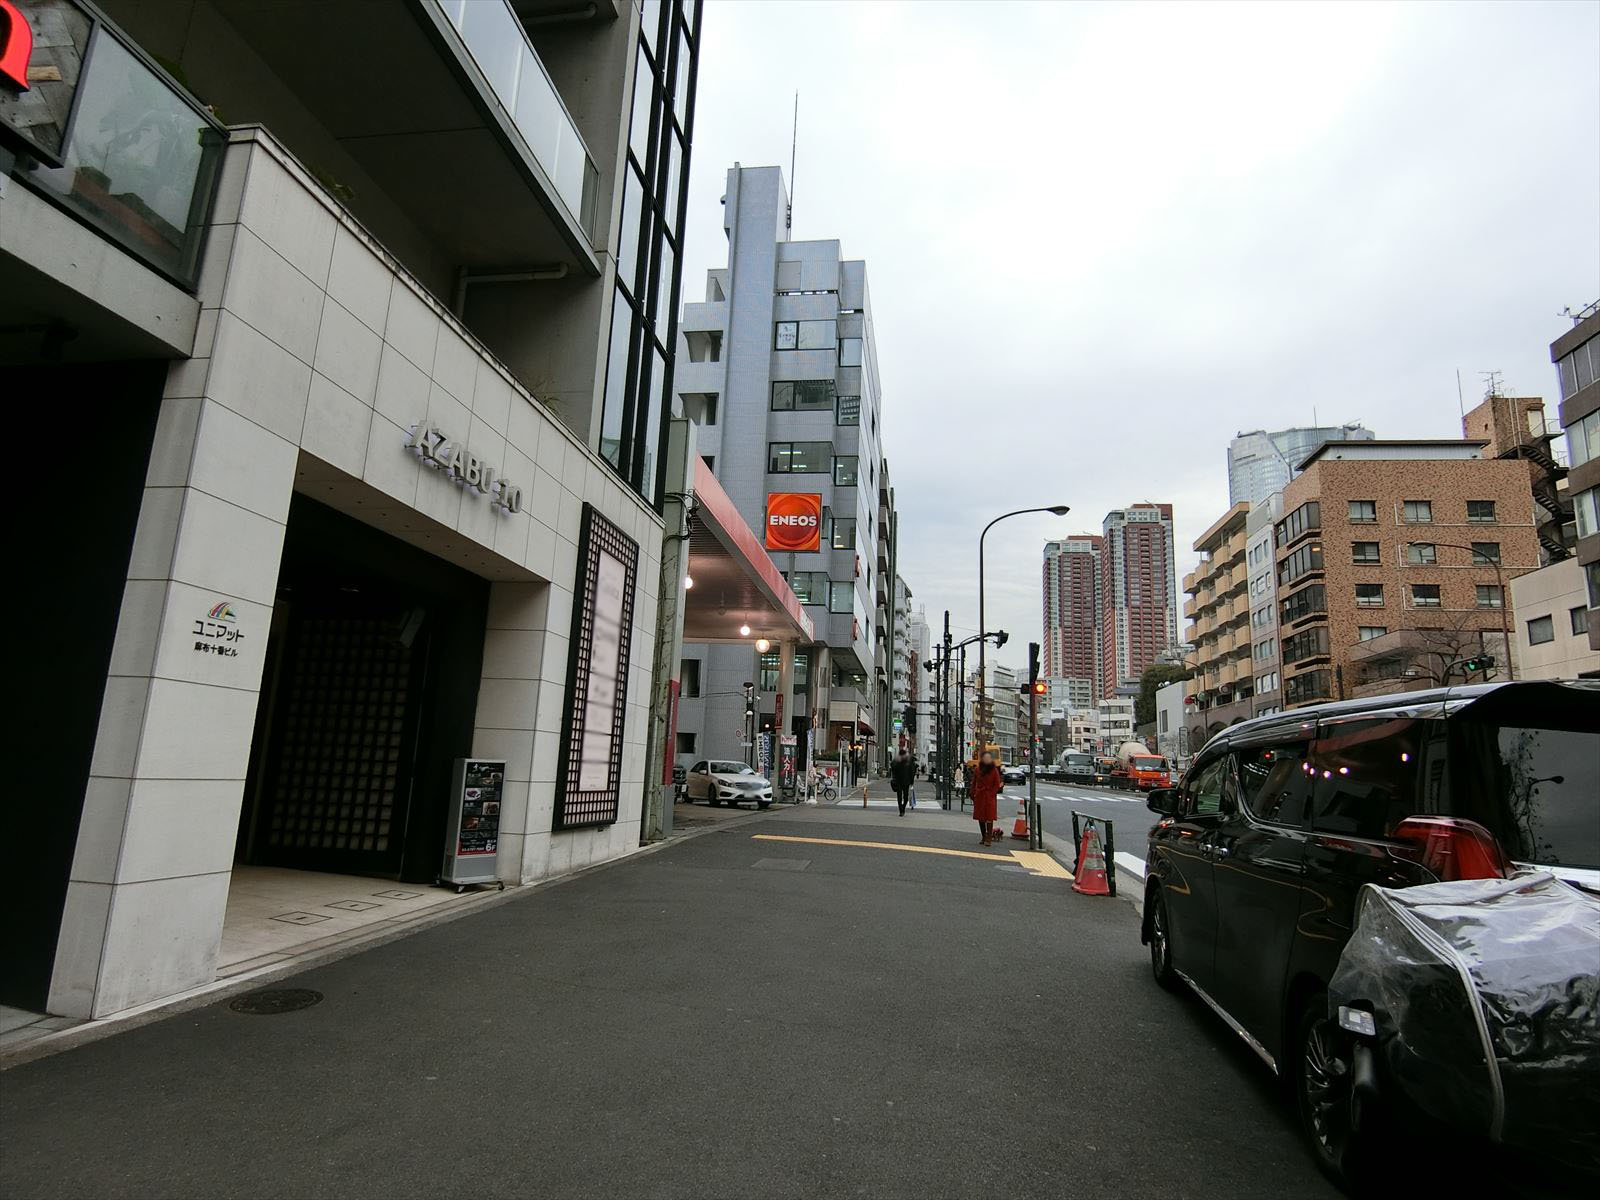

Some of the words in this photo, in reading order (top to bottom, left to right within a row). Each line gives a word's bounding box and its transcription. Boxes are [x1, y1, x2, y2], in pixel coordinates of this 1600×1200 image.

[410, 420, 495, 494] AZABU
[769, 515, 817, 527] ENEOS
[193, 620, 245, 643] ユニマット
